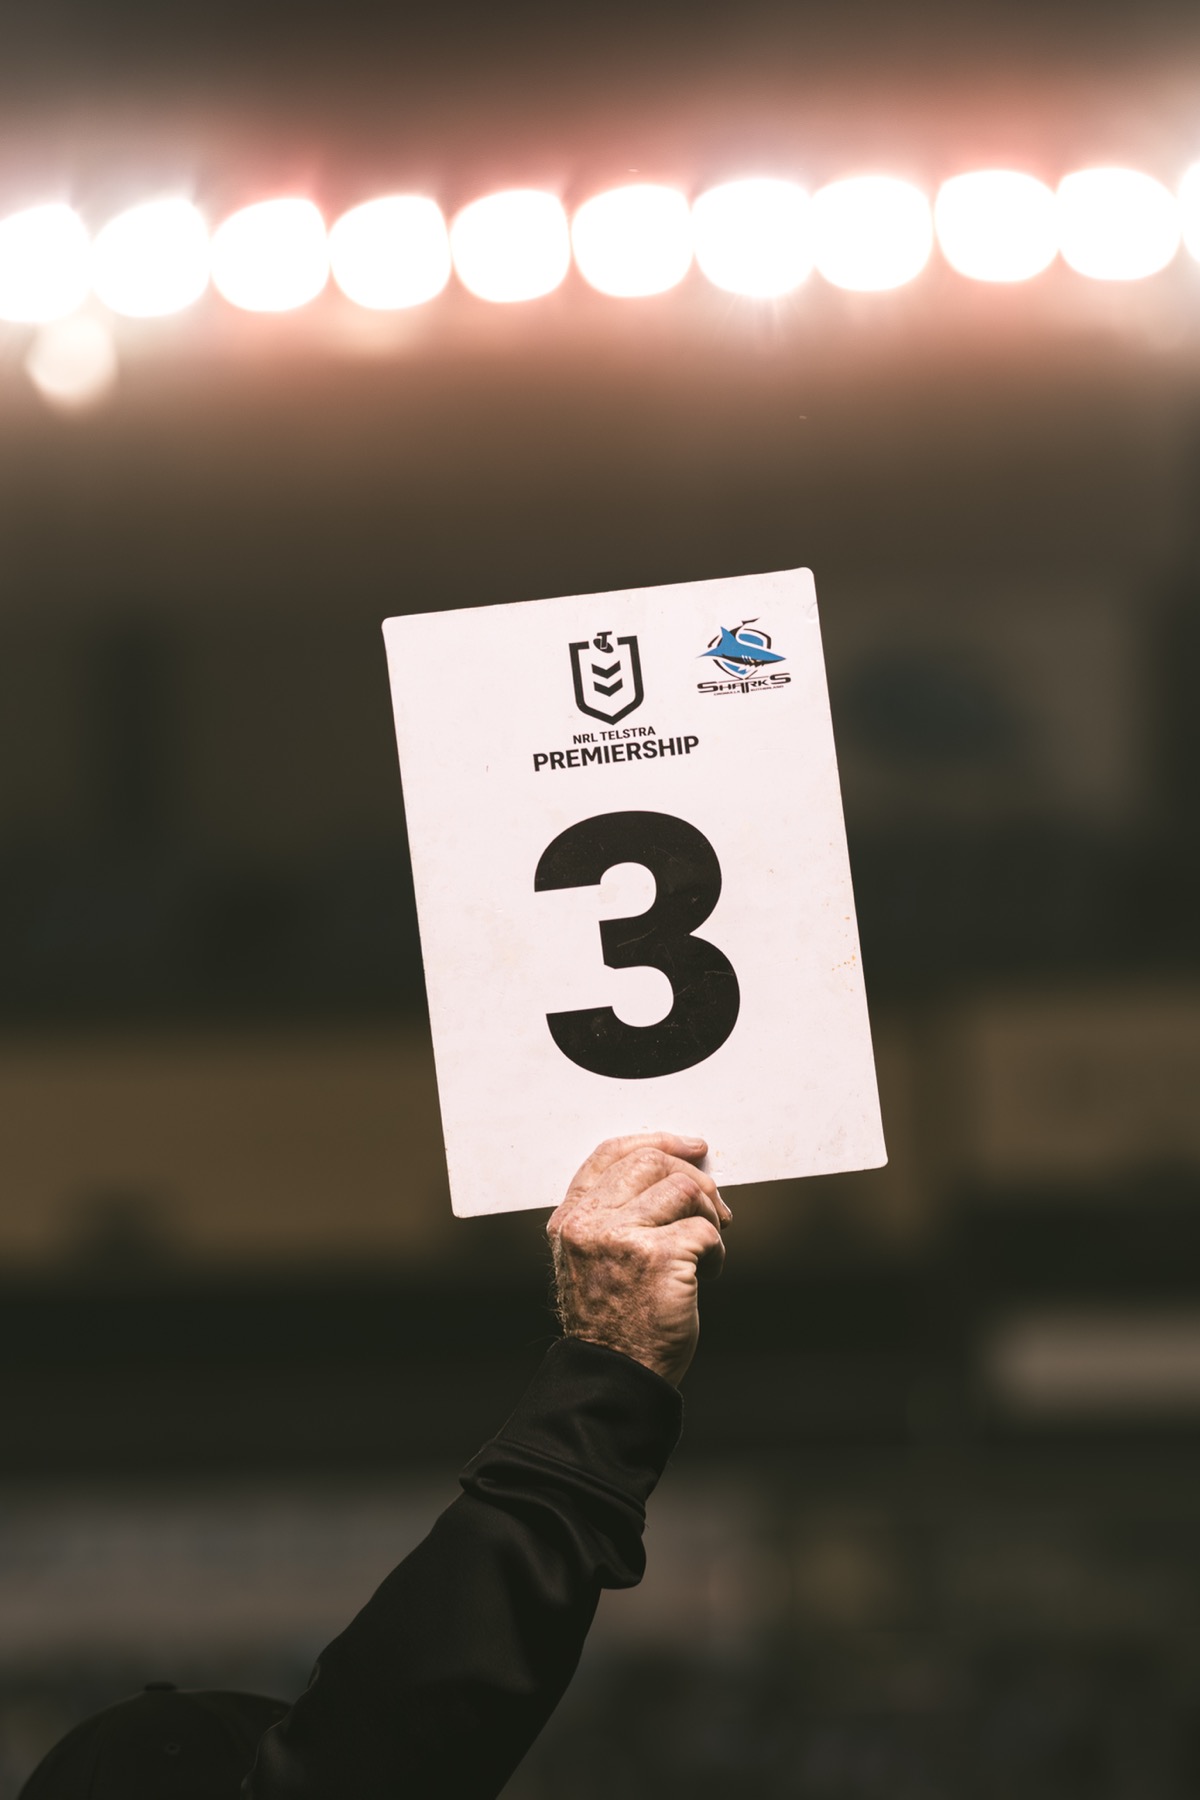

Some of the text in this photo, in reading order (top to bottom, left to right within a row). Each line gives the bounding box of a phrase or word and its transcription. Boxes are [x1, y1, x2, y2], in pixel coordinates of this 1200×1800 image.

[697, 672, 792, 694] SHARKS
[572, 725, 656, 745] NRL TELSTRA
[533, 735, 700, 772] PREMIERSHIP
[535, 811, 740, 1079] 3
